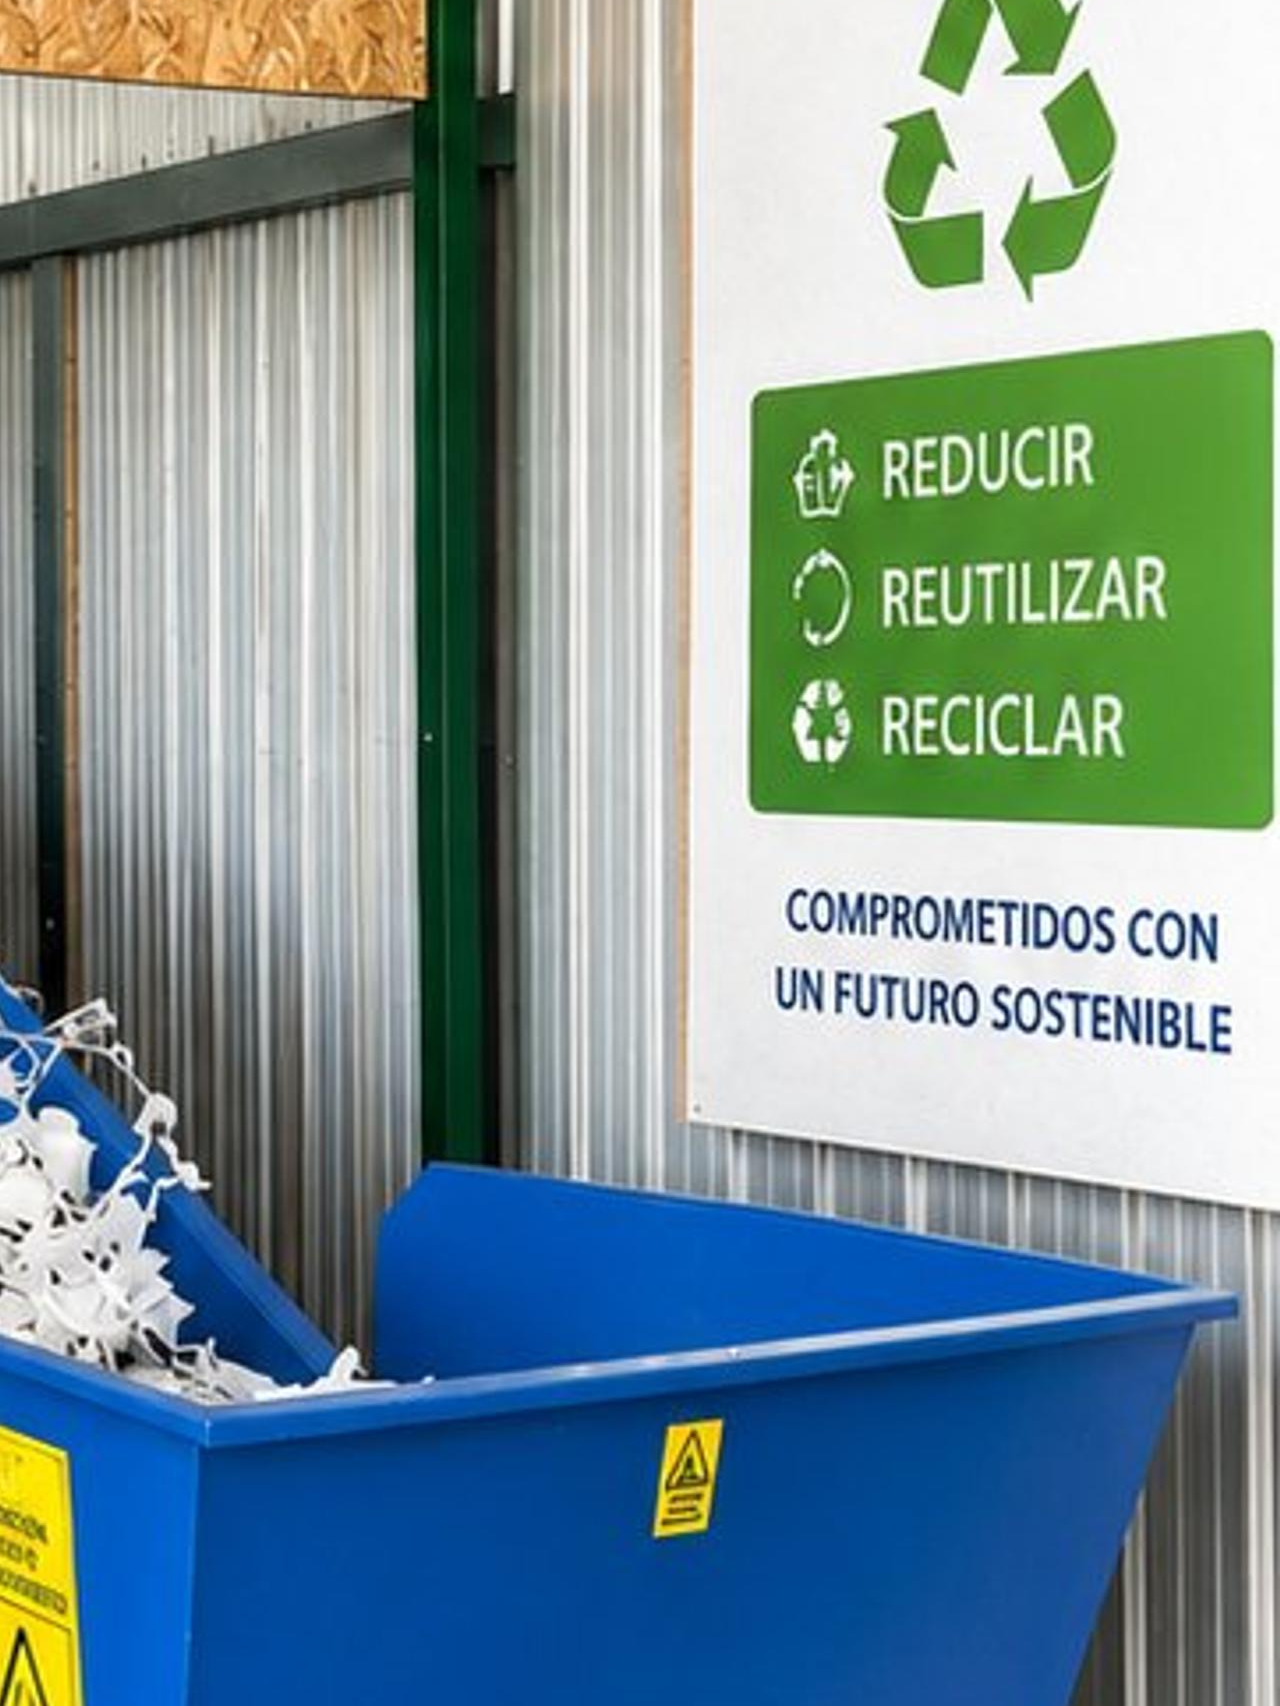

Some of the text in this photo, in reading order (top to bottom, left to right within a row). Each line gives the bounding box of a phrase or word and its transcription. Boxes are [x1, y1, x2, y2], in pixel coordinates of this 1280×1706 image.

[883, 423, 1094, 499] REDUCIR
[883, 555, 1167, 628] REUTILIZAR
[883, 693, 1125, 758] RECICLAR
[786, 888, 1219, 963] COMPROMETIDOS CON
[776, 966, 1233, 1055] UN FUTURO SOSTENIBLE
